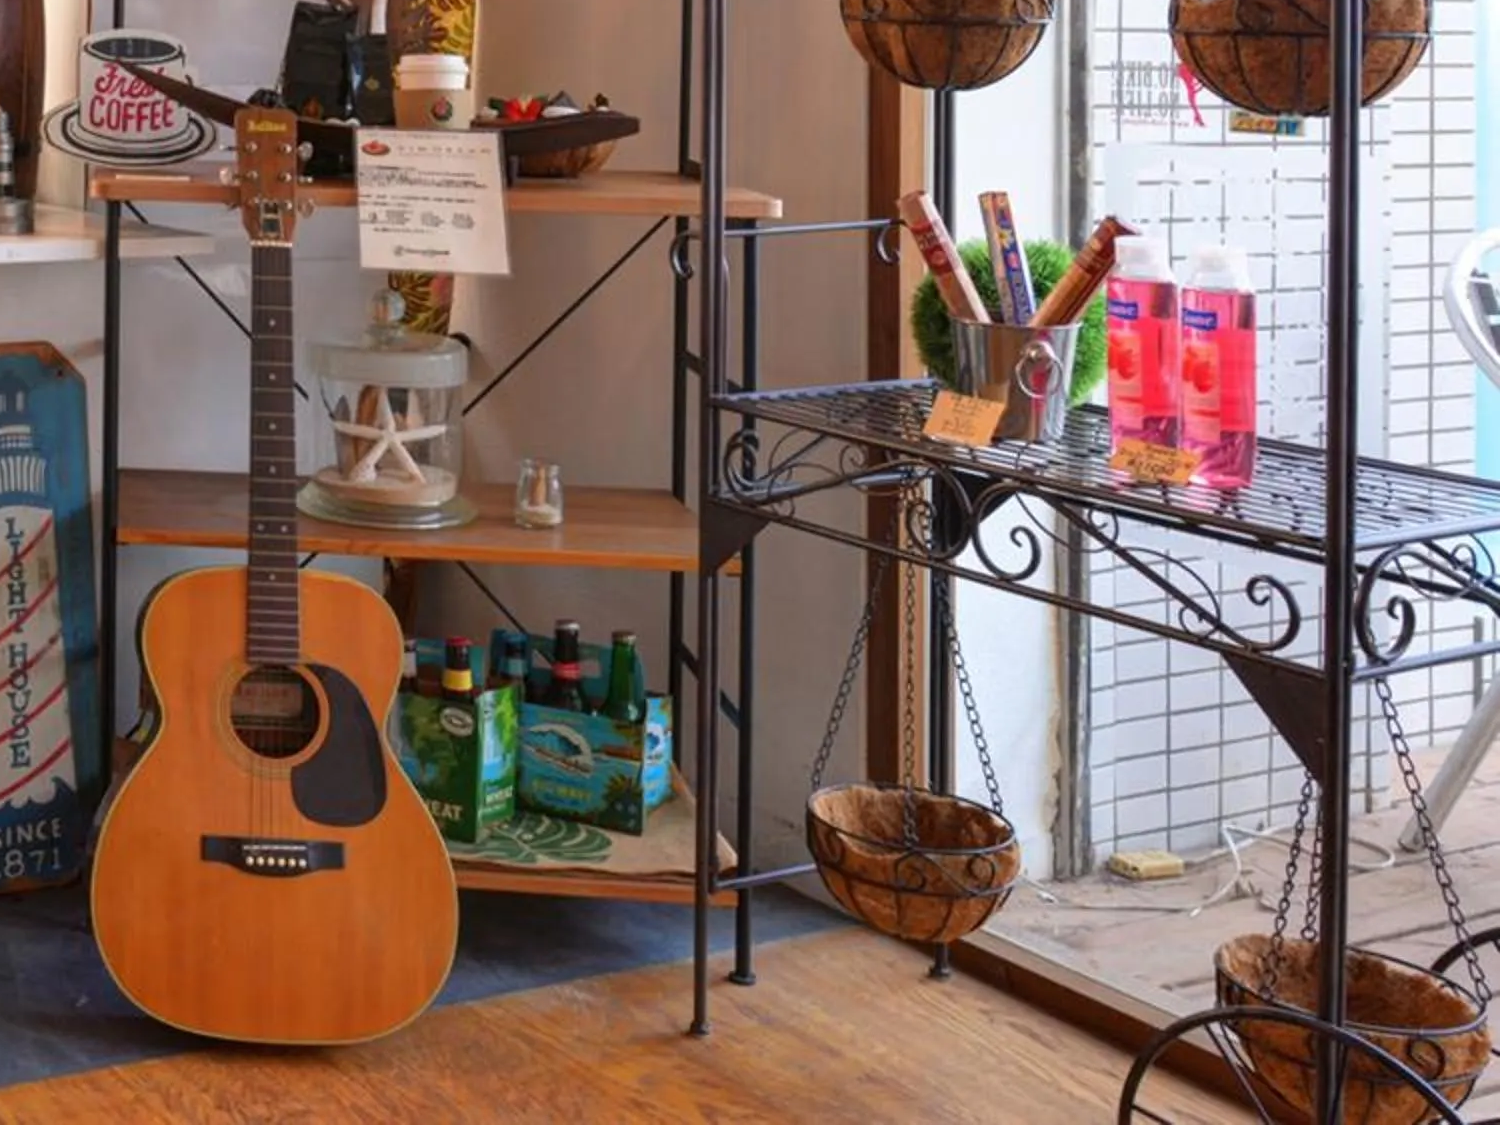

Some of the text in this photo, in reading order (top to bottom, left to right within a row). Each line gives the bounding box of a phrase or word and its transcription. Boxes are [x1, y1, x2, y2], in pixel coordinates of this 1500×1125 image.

[94, 62, 166, 99] Fres
[89, 96, 176, 133] COFFEE
[5, 517, 31, 768] LIGHT HOUSE
